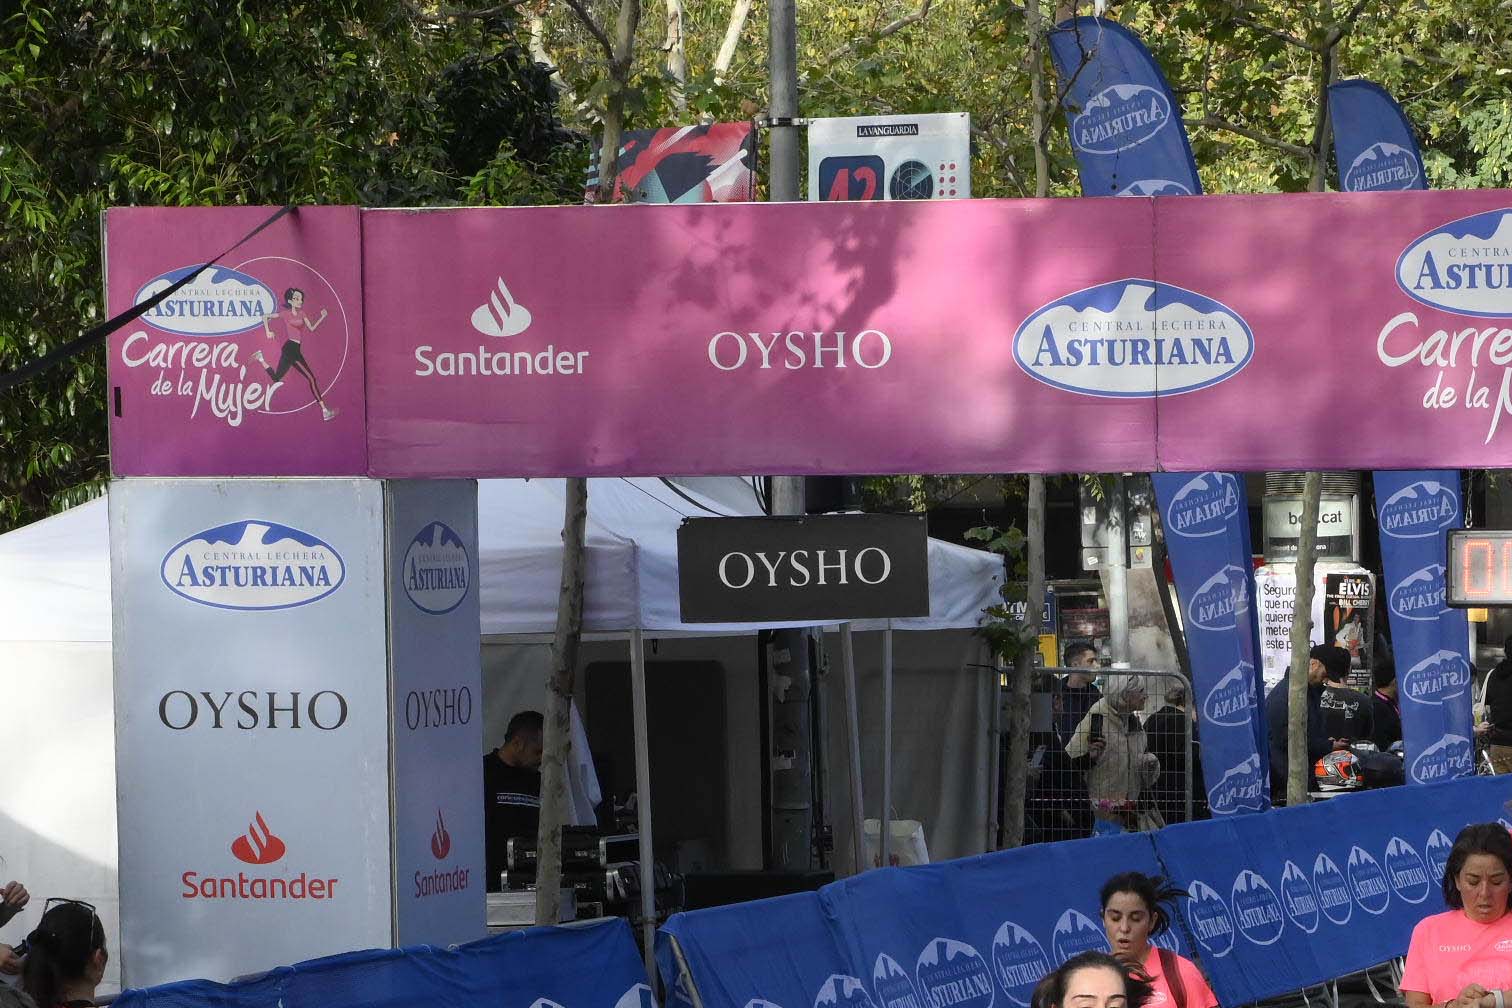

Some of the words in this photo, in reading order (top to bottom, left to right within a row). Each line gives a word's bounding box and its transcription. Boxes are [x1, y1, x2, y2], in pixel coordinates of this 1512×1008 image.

[173, 288, 210, 297] ENTRAL
[1068, 320, 1147, 332] CENTRAL
[121, 330, 240, 369] Carrera
[414, 343, 590, 378] Santander
[707, 328, 893, 371] OYSHO
[1031, 321, 1234, 368] ASTURIANA
[151, 370, 173, 396] de
[177, 370, 194, 396] la
[190, 364, 284, 427] Mujer
[1422, 370, 1457, 409] de
[1465, 367, 1490, 409] la
[175, 553, 332, 588] ASTURIANA
[203, 551, 260, 561] CENTRAL
[267, 551, 326, 561] LECHERA
[408, 556, 466, 592] ASTURIANA
[717, 545, 892, 590] OYSHO
[1339, 582, 1370, 595] ELVIS
[158, 690, 349, 730] OYSHO
[405, 686, 472, 730] OYSHO
[181, 871, 338, 900] Santander
[414, 865, 470, 898] Santander
